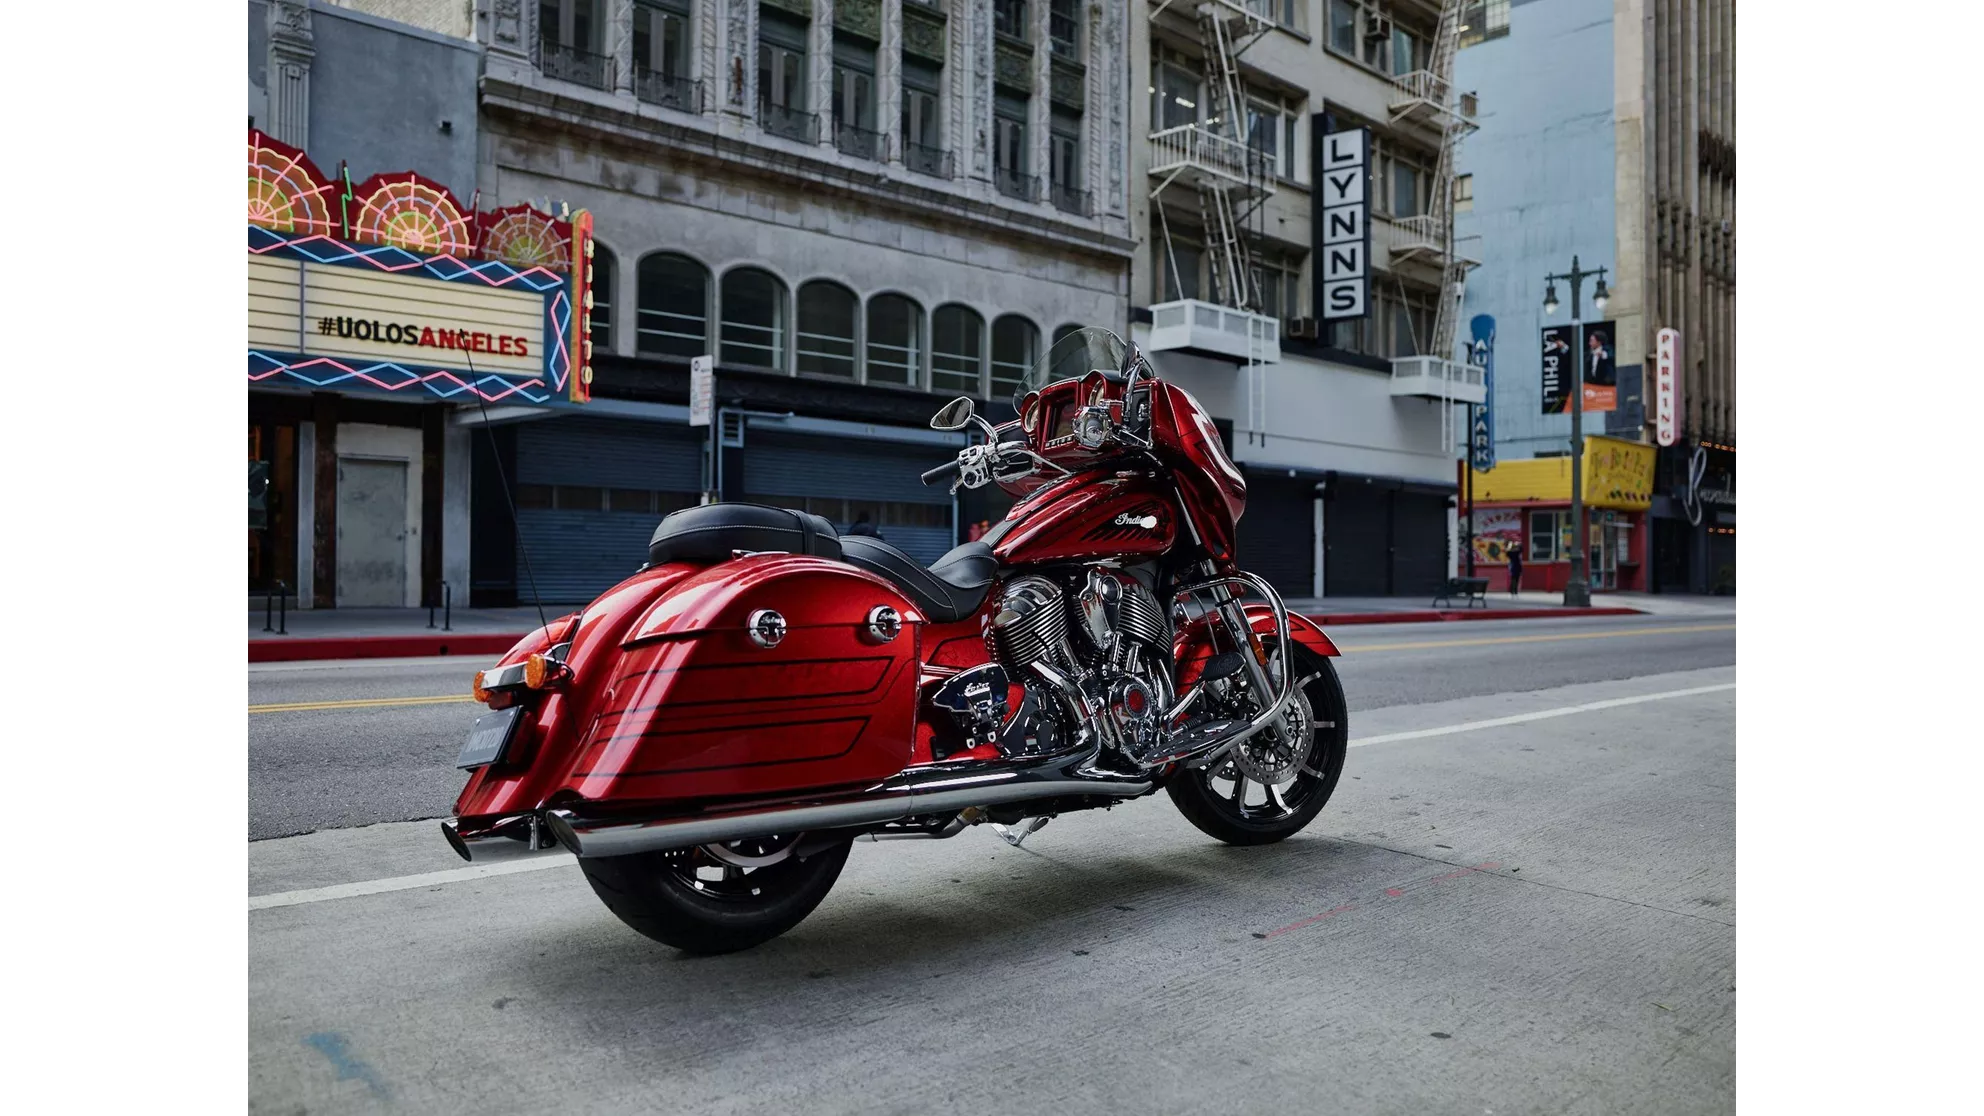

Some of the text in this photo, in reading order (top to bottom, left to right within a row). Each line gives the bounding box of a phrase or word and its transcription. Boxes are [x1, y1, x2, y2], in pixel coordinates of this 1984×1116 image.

[1329, 139, 1357, 312] LYNNS
[317, 316, 529, 357] #UOLOSANGELES
[1543, 329, 1559, 354] LA
[1543, 355, 1559, 397] PHIL
[1661, 334, 1671, 440] PARKING
[1474, 404, 1489, 463] PARK
[1114, 512, 1148, 527] Indi
